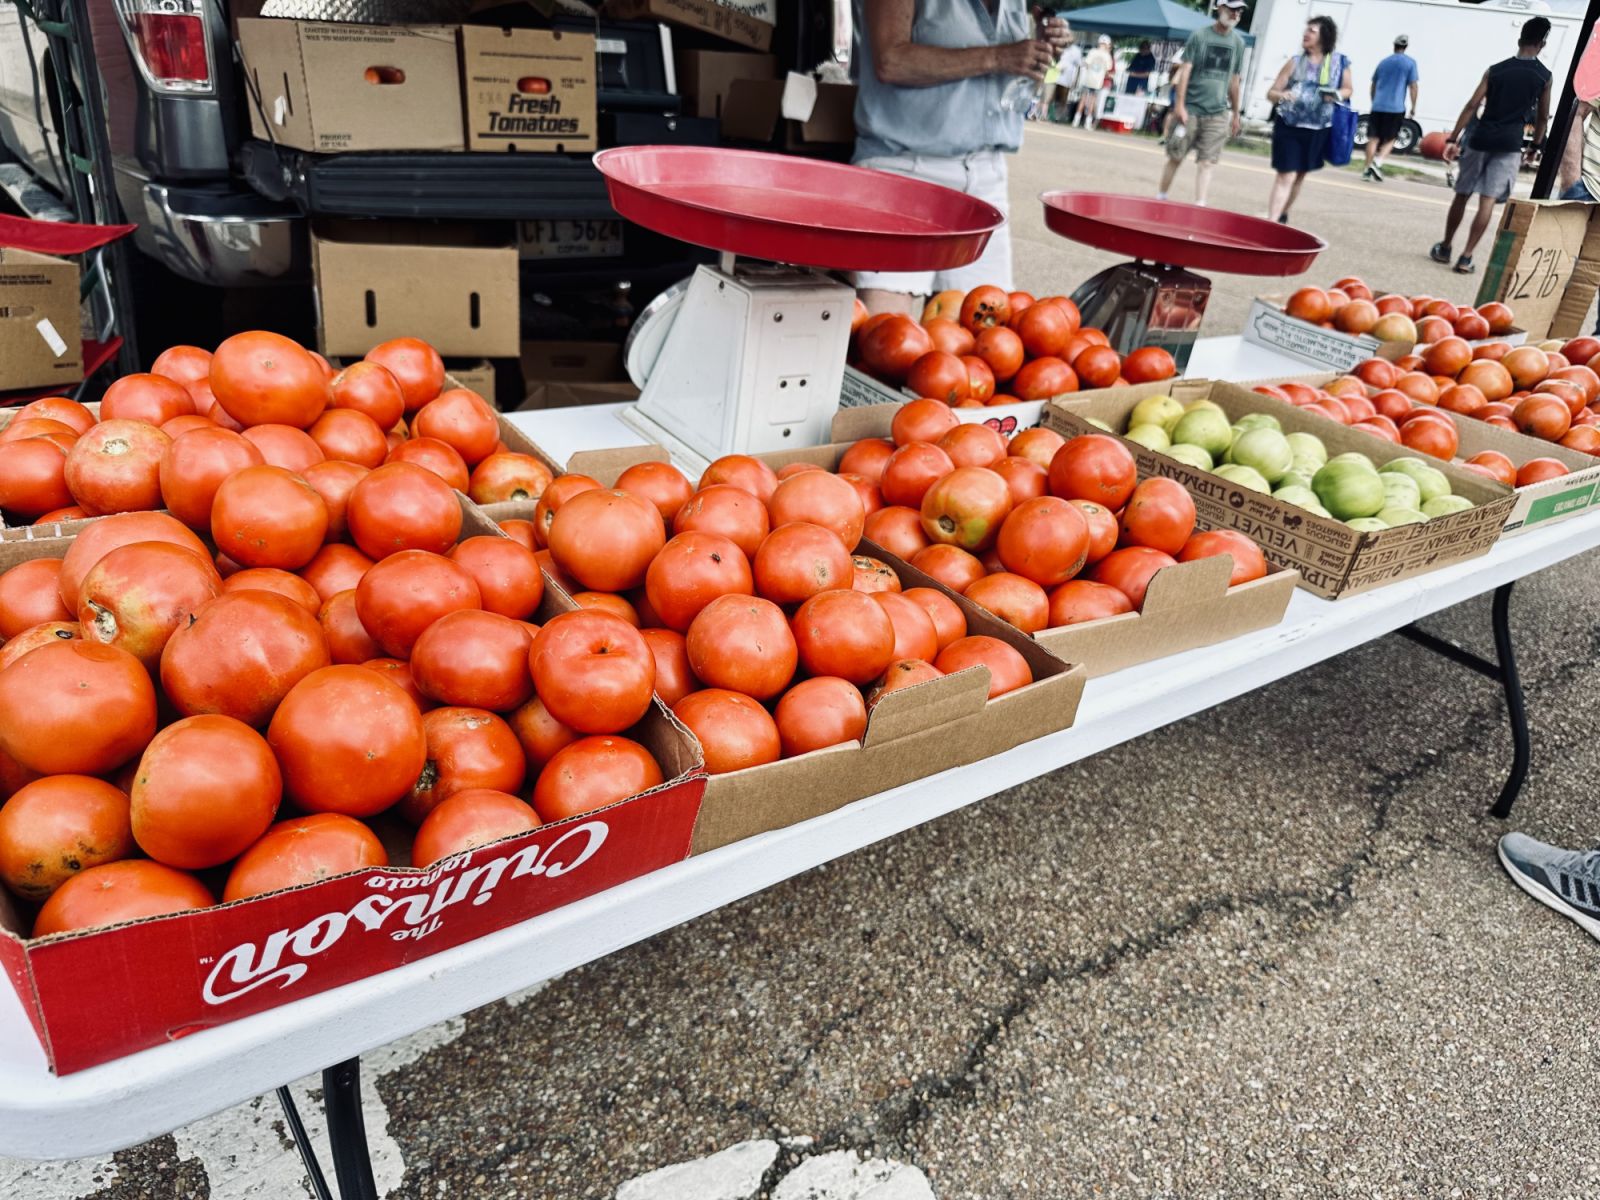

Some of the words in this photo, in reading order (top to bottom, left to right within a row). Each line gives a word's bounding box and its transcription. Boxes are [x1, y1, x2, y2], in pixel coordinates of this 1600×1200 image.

[508, 93, 561, 114] Fresh
[488, 111, 579, 133] Tomatoes
[1158, 462, 1227, 502] LIPMAN
[1229, 513, 1298, 554] VELVET
[1305, 520, 1354, 542] TOMATOES
[1305, 527, 1352, 550] DELICIOUS
[1318, 556, 1346, 573] family
[1320, 550, 1347, 564] farms
[1352, 549, 1399, 571] VELVET
[364, 851, 474, 889] tomato
[203, 821, 609, 1005] Crimson
[390, 914, 444, 942] The
